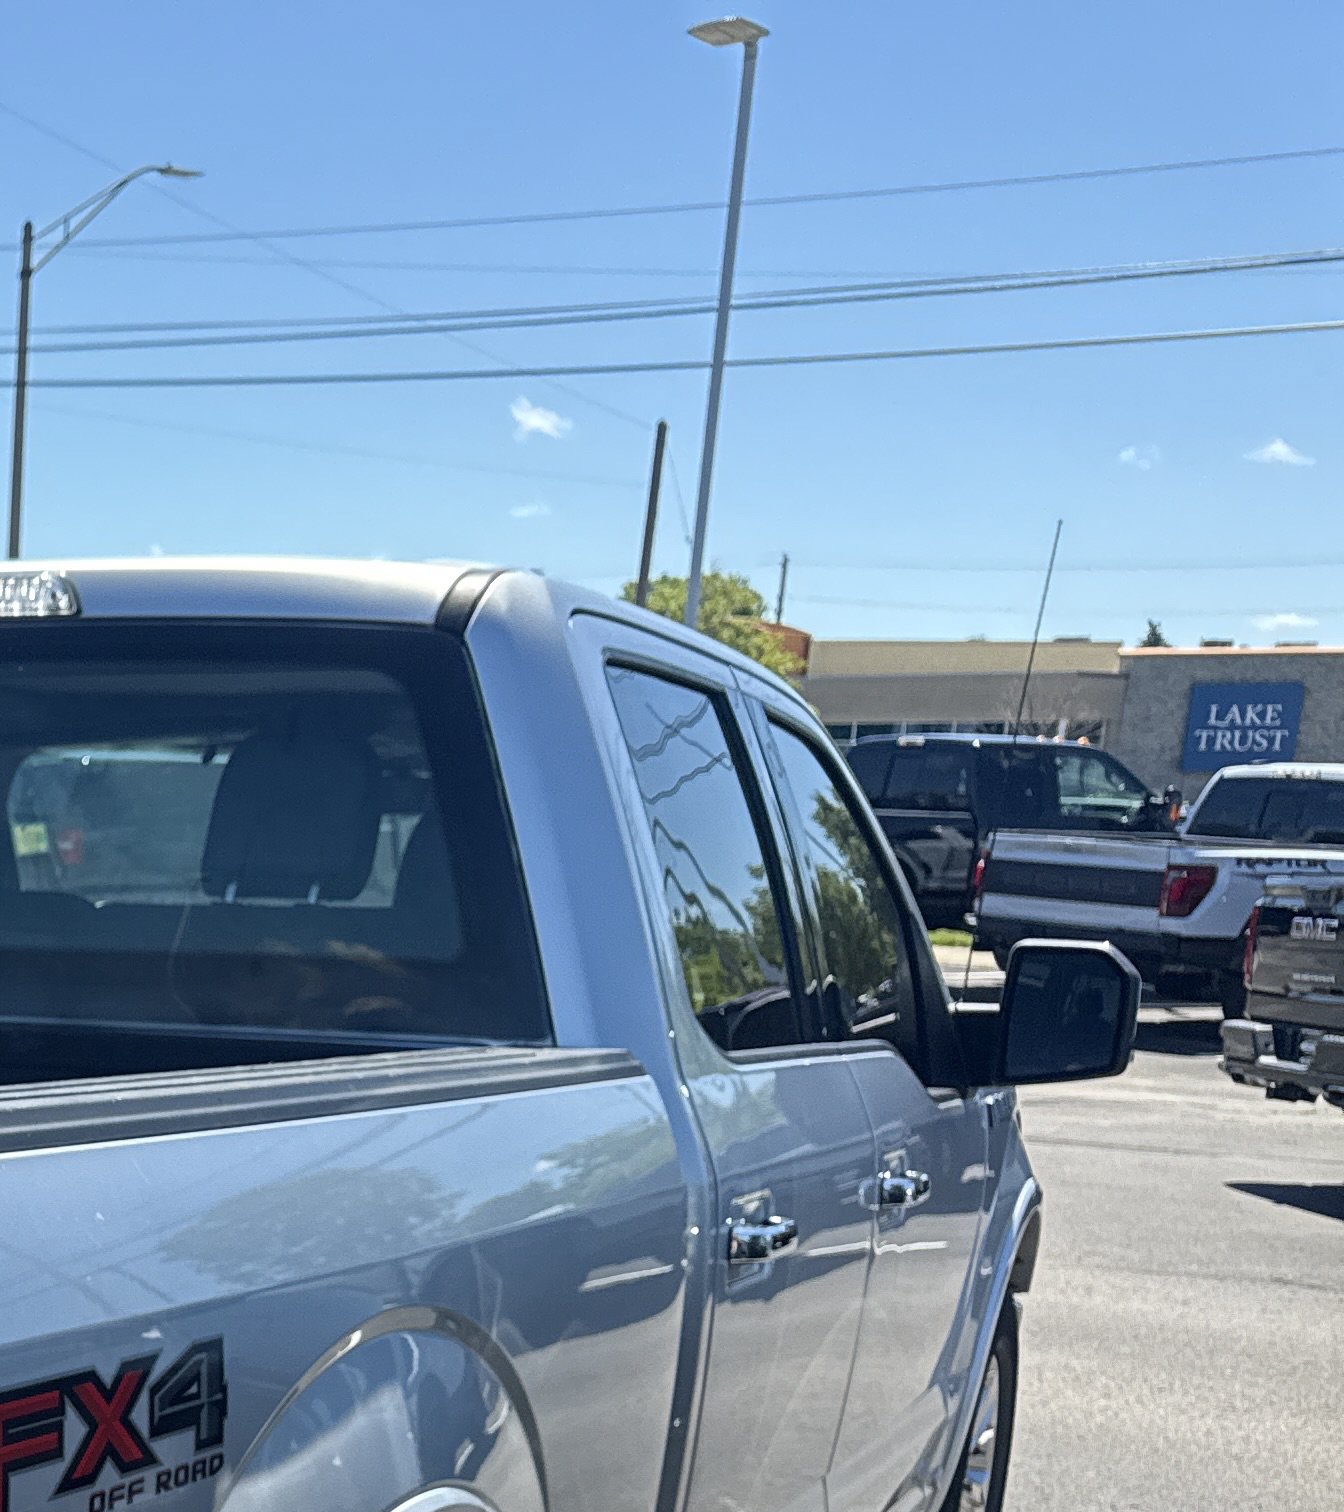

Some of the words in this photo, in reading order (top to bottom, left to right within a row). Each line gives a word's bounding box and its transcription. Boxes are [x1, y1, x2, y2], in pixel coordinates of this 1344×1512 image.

[1208, 703, 1283, 727] LAKE
[1194, 729, 1289, 752] TRUST
[1291, 917, 1338, 941] GMC
[155, 1453, 224, 1495] ROAD
